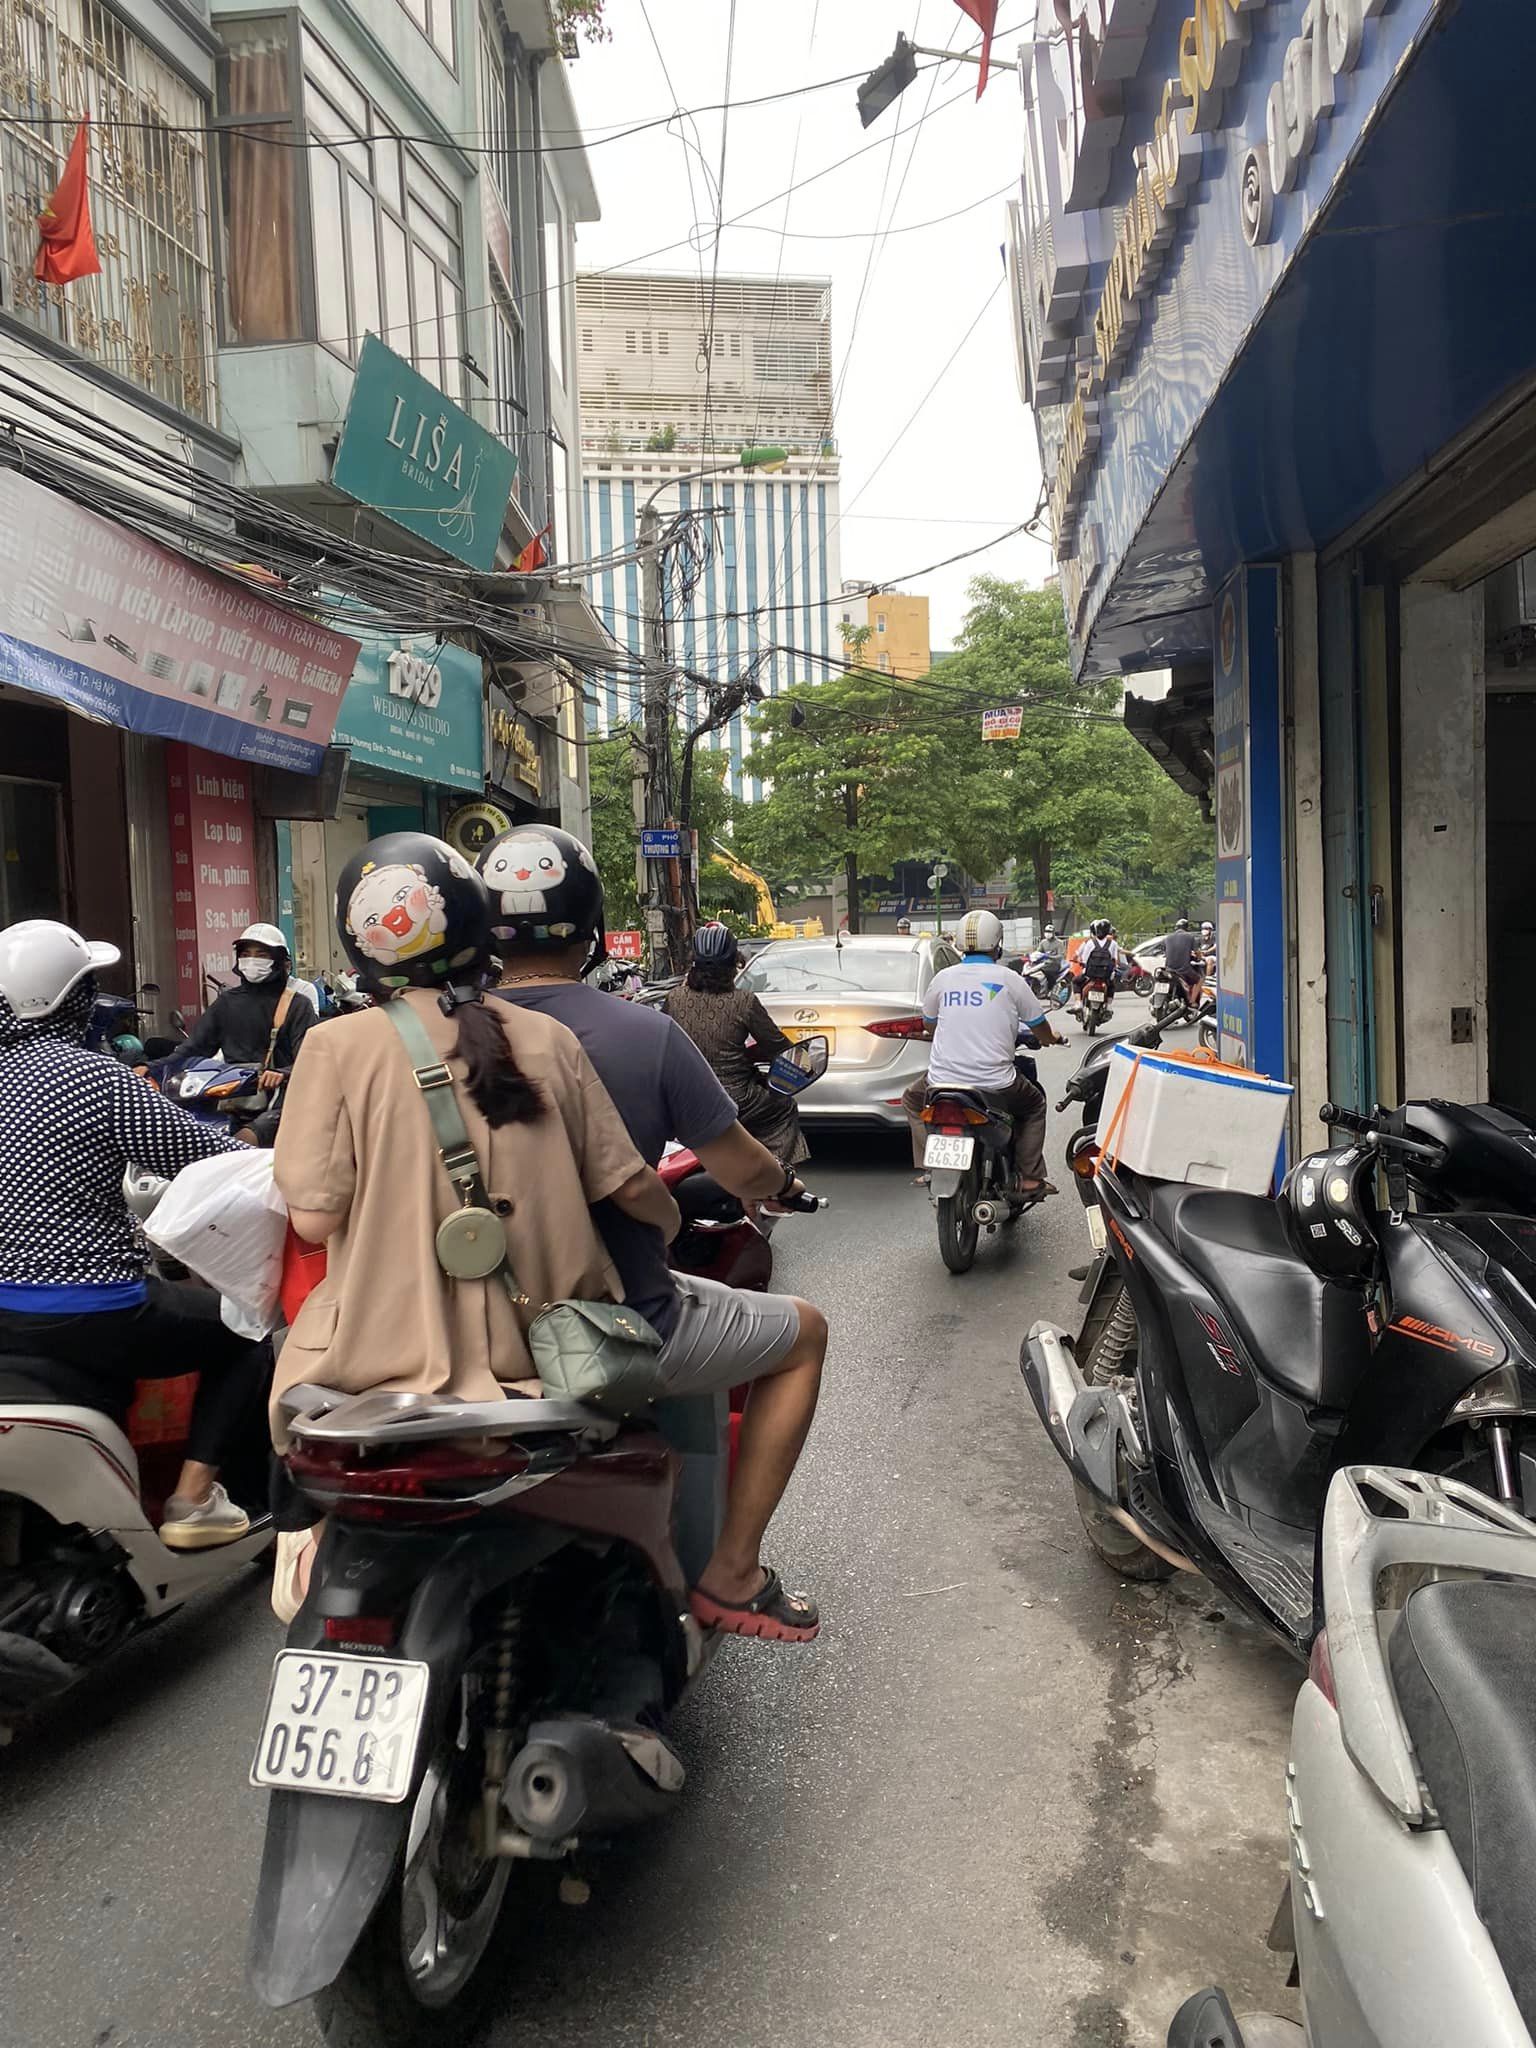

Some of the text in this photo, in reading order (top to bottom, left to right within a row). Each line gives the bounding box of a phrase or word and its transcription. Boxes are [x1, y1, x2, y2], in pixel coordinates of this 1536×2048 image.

[401, 460, 435, 492] BRIDAL
[132, 550, 166, 581] MẠI
[167, 566, 186, 591] VÀ
[187, 576, 218, 609] DỊCH
[263, 608, 289, 637] TÍNH
[76, 562, 121, 608] LINH
[120, 583, 161, 625] KIỆN
[216, 626, 252, 661] THIẾT
[251, 640, 266, 671] BỊ
[301, 663, 343, 697] CAMERA
[386, 649, 443, 709] 1989
[372, 695, 418, 726] WEDDING
[417, 710, 450, 738] STUDIO
[196, 774, 245, 804] Linh kiện
[204, 819, 224, 844] Lap
[225, 822, 242, 845] top
[200, 863, 222, 887] Pin,
[205, 907, 250, 932] Sạc, hdd
[613, 932, 633, 944] CẤM
[625, 946, 636, 957] XE
[944, 991, 983, 1007] IRIS
[927, 1151, 969, 1168] 646.20
[339, 1641, 385, 1653] HONDA
[291, 1663, 403, 1722] 37-B3
